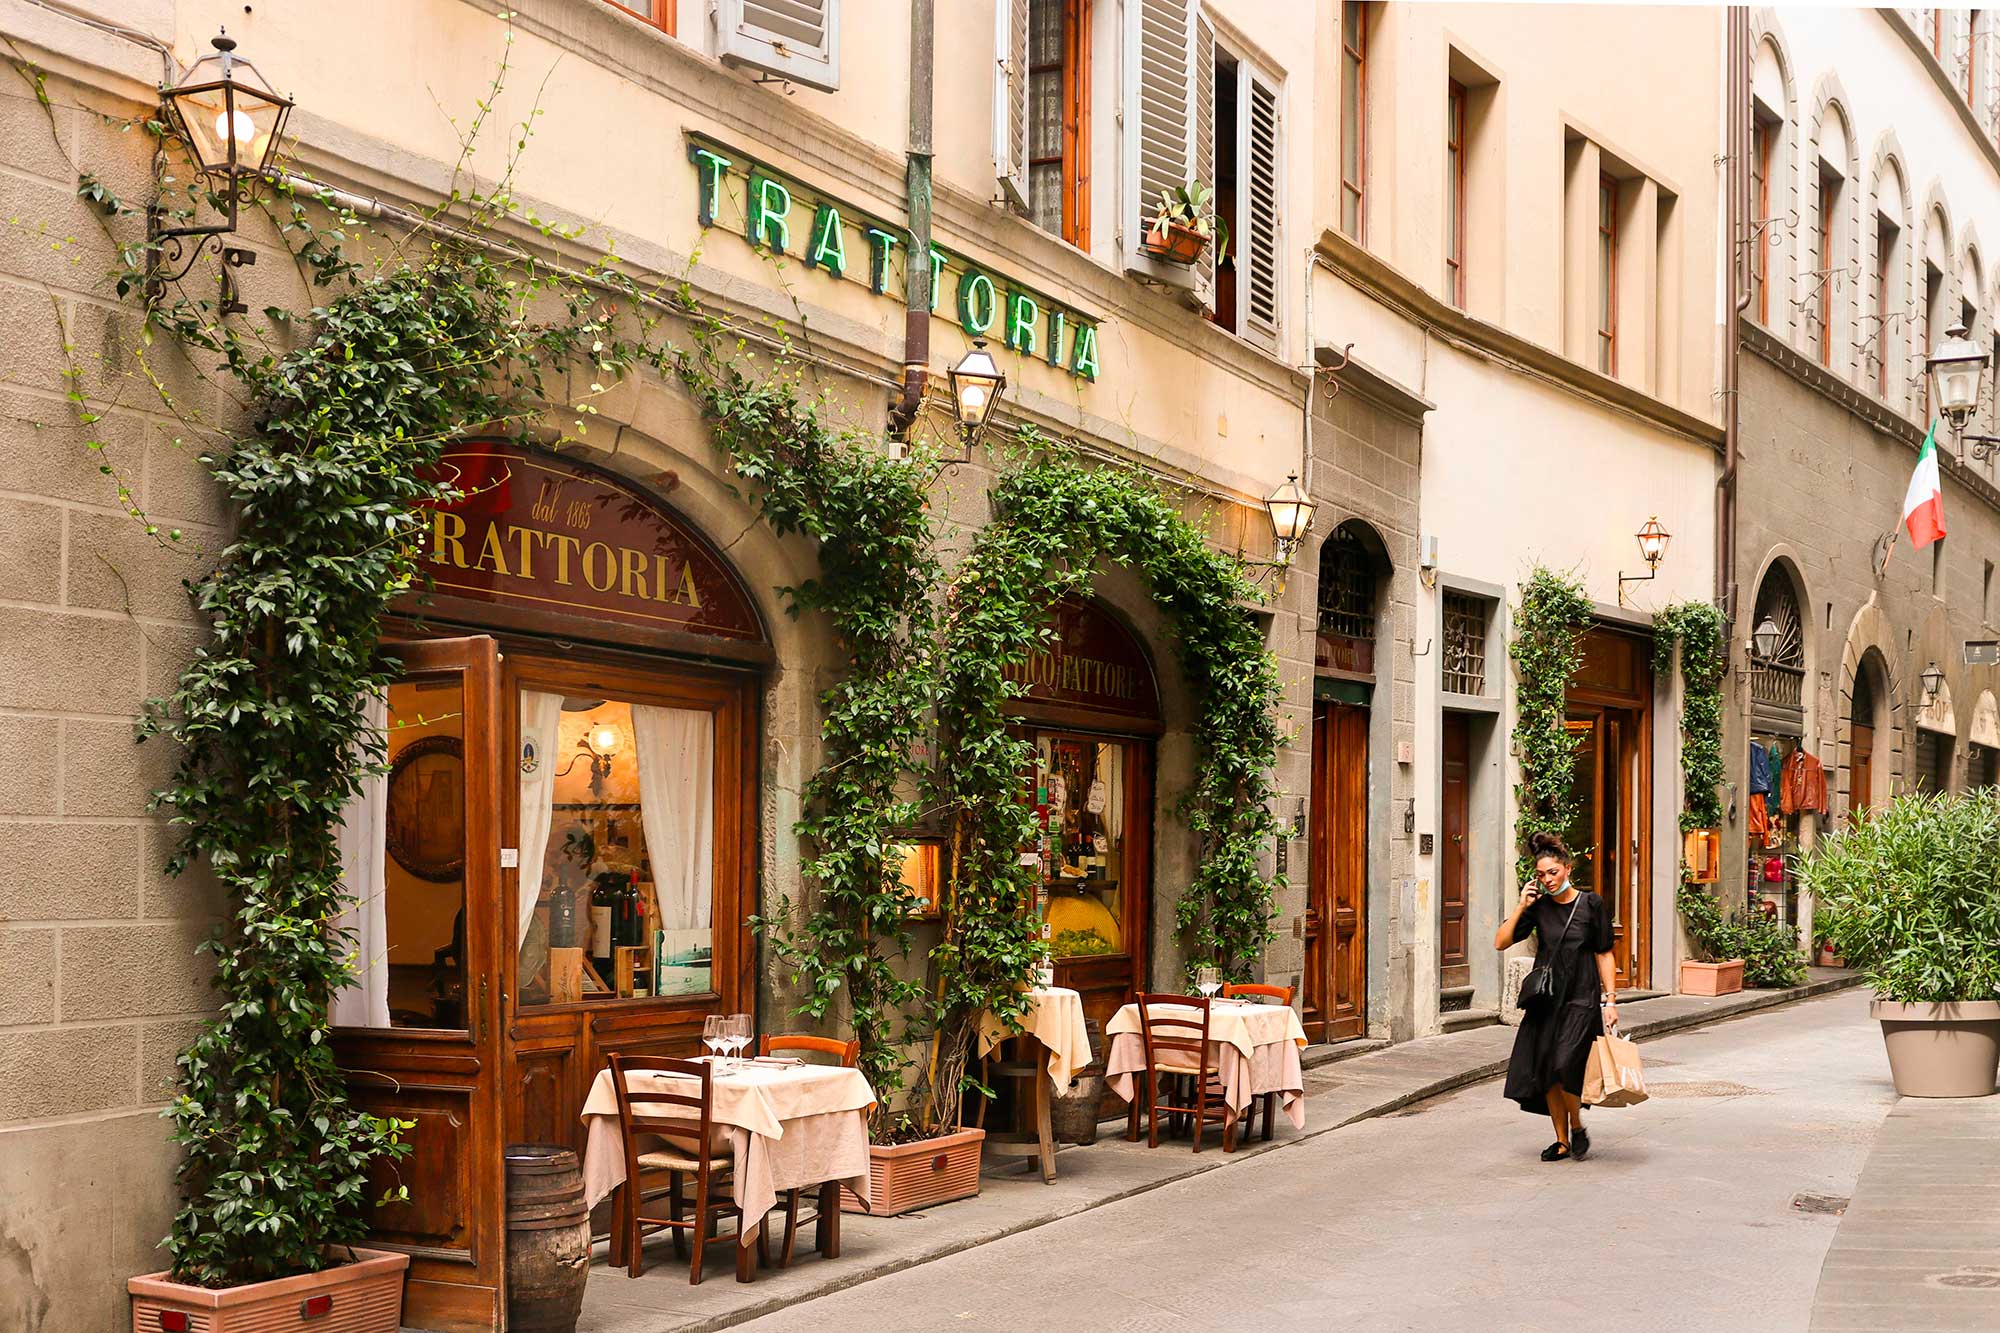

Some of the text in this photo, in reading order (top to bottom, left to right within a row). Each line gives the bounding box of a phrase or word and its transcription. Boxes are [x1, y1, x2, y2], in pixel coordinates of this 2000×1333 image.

[688, 143, 1100, 383] TRATTORIA
[532, 481, 593, 530] dal 1865
[1062, 655, 1137, 700] FATTORE
